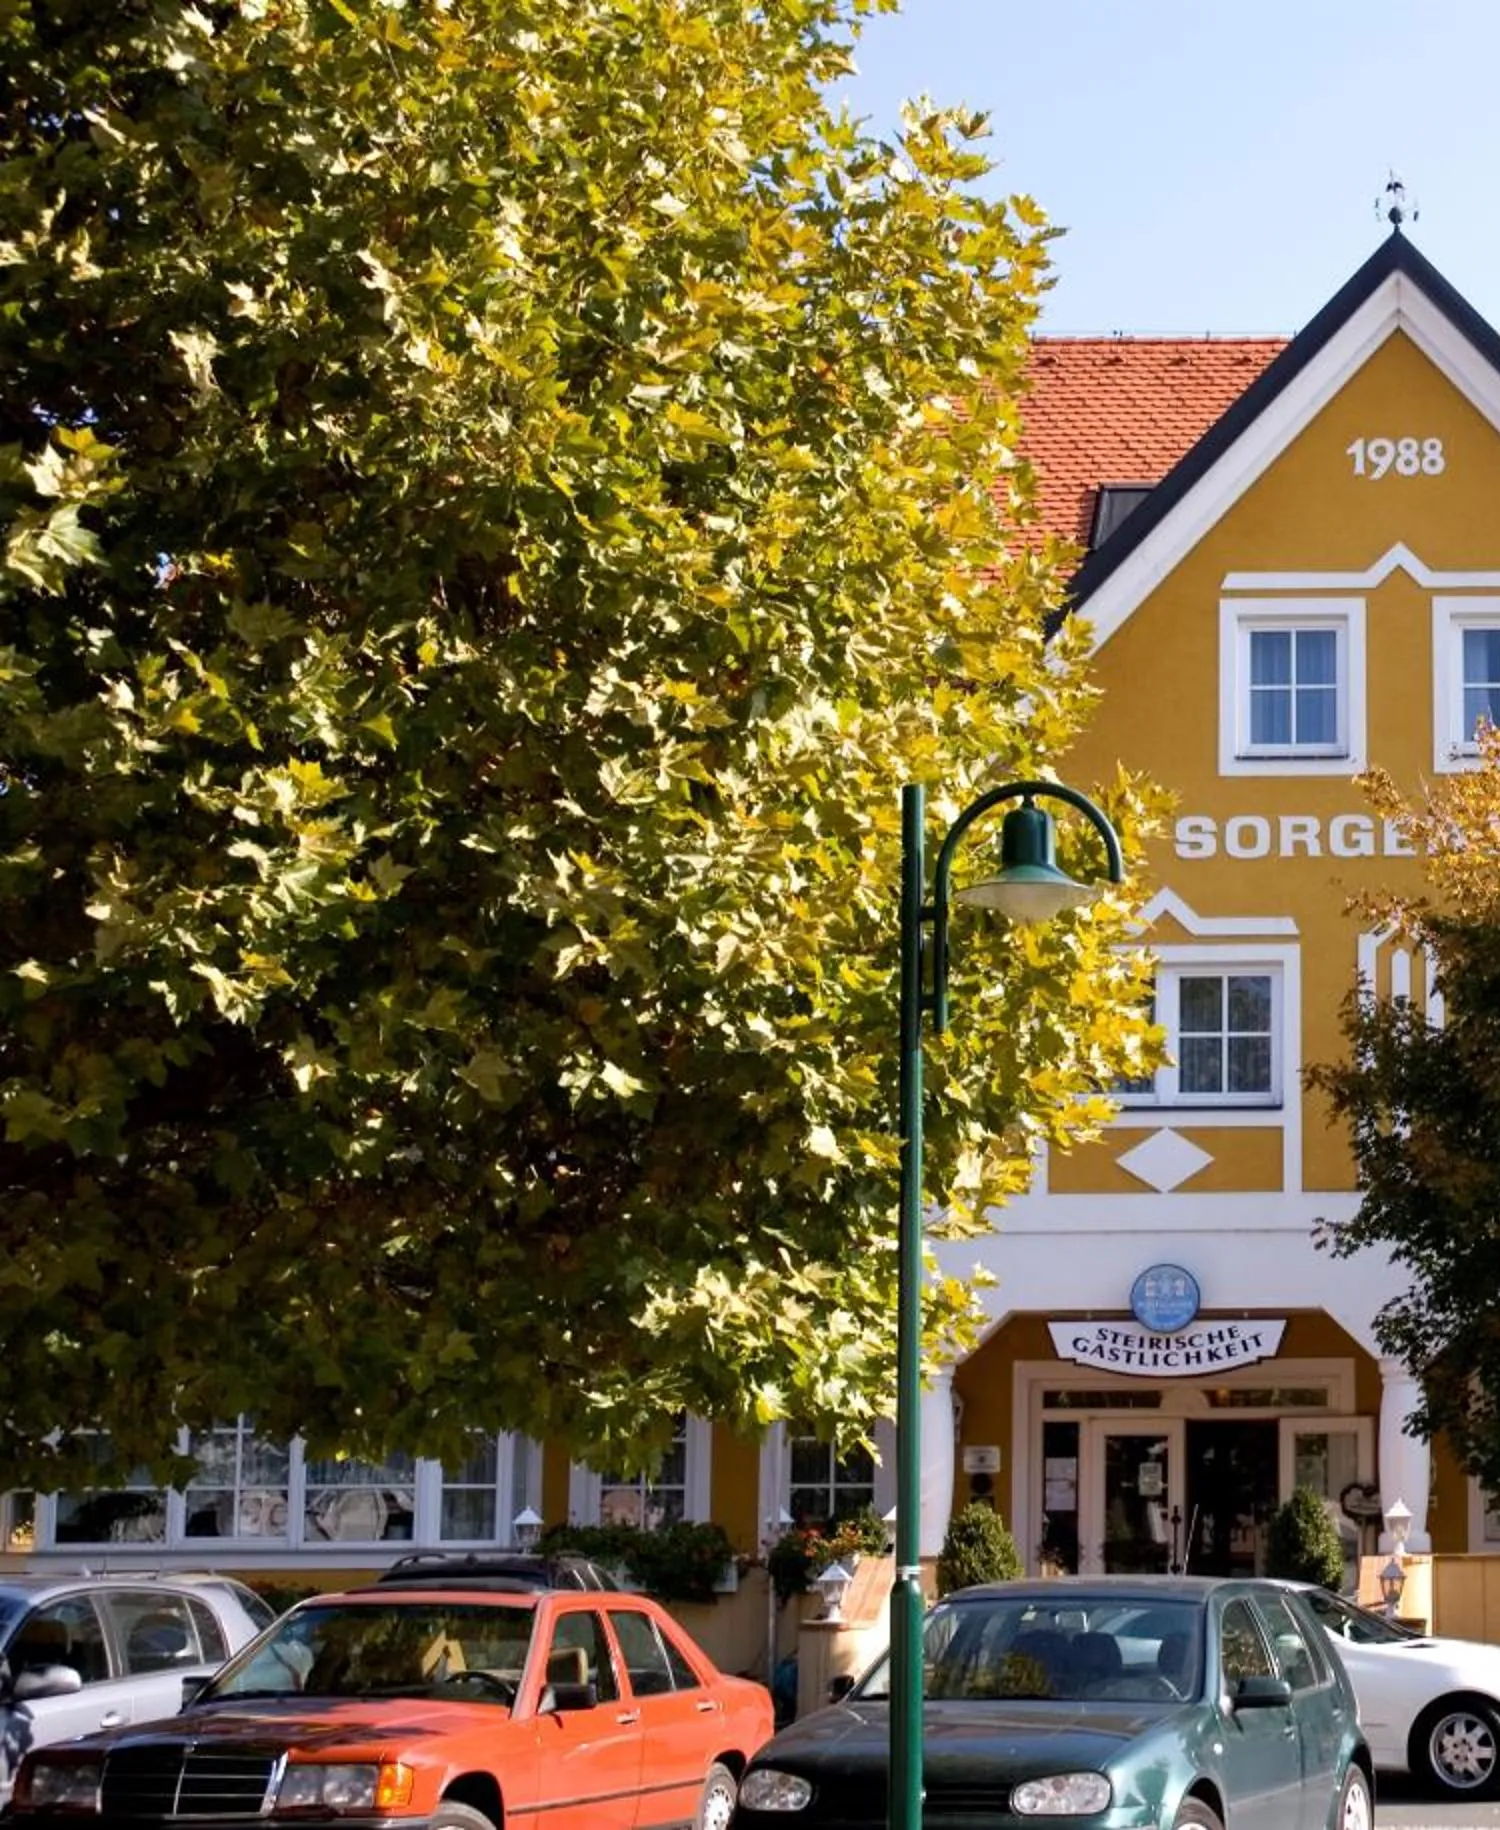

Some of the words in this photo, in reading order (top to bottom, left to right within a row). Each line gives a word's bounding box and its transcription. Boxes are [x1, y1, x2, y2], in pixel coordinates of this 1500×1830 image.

[1346, 437, 1445, 480] 1988
[1072, 1332, 1264, 1368] GASTLICHKEIT
[1097, 1325, 1241, 1351] STEIRISCHE
